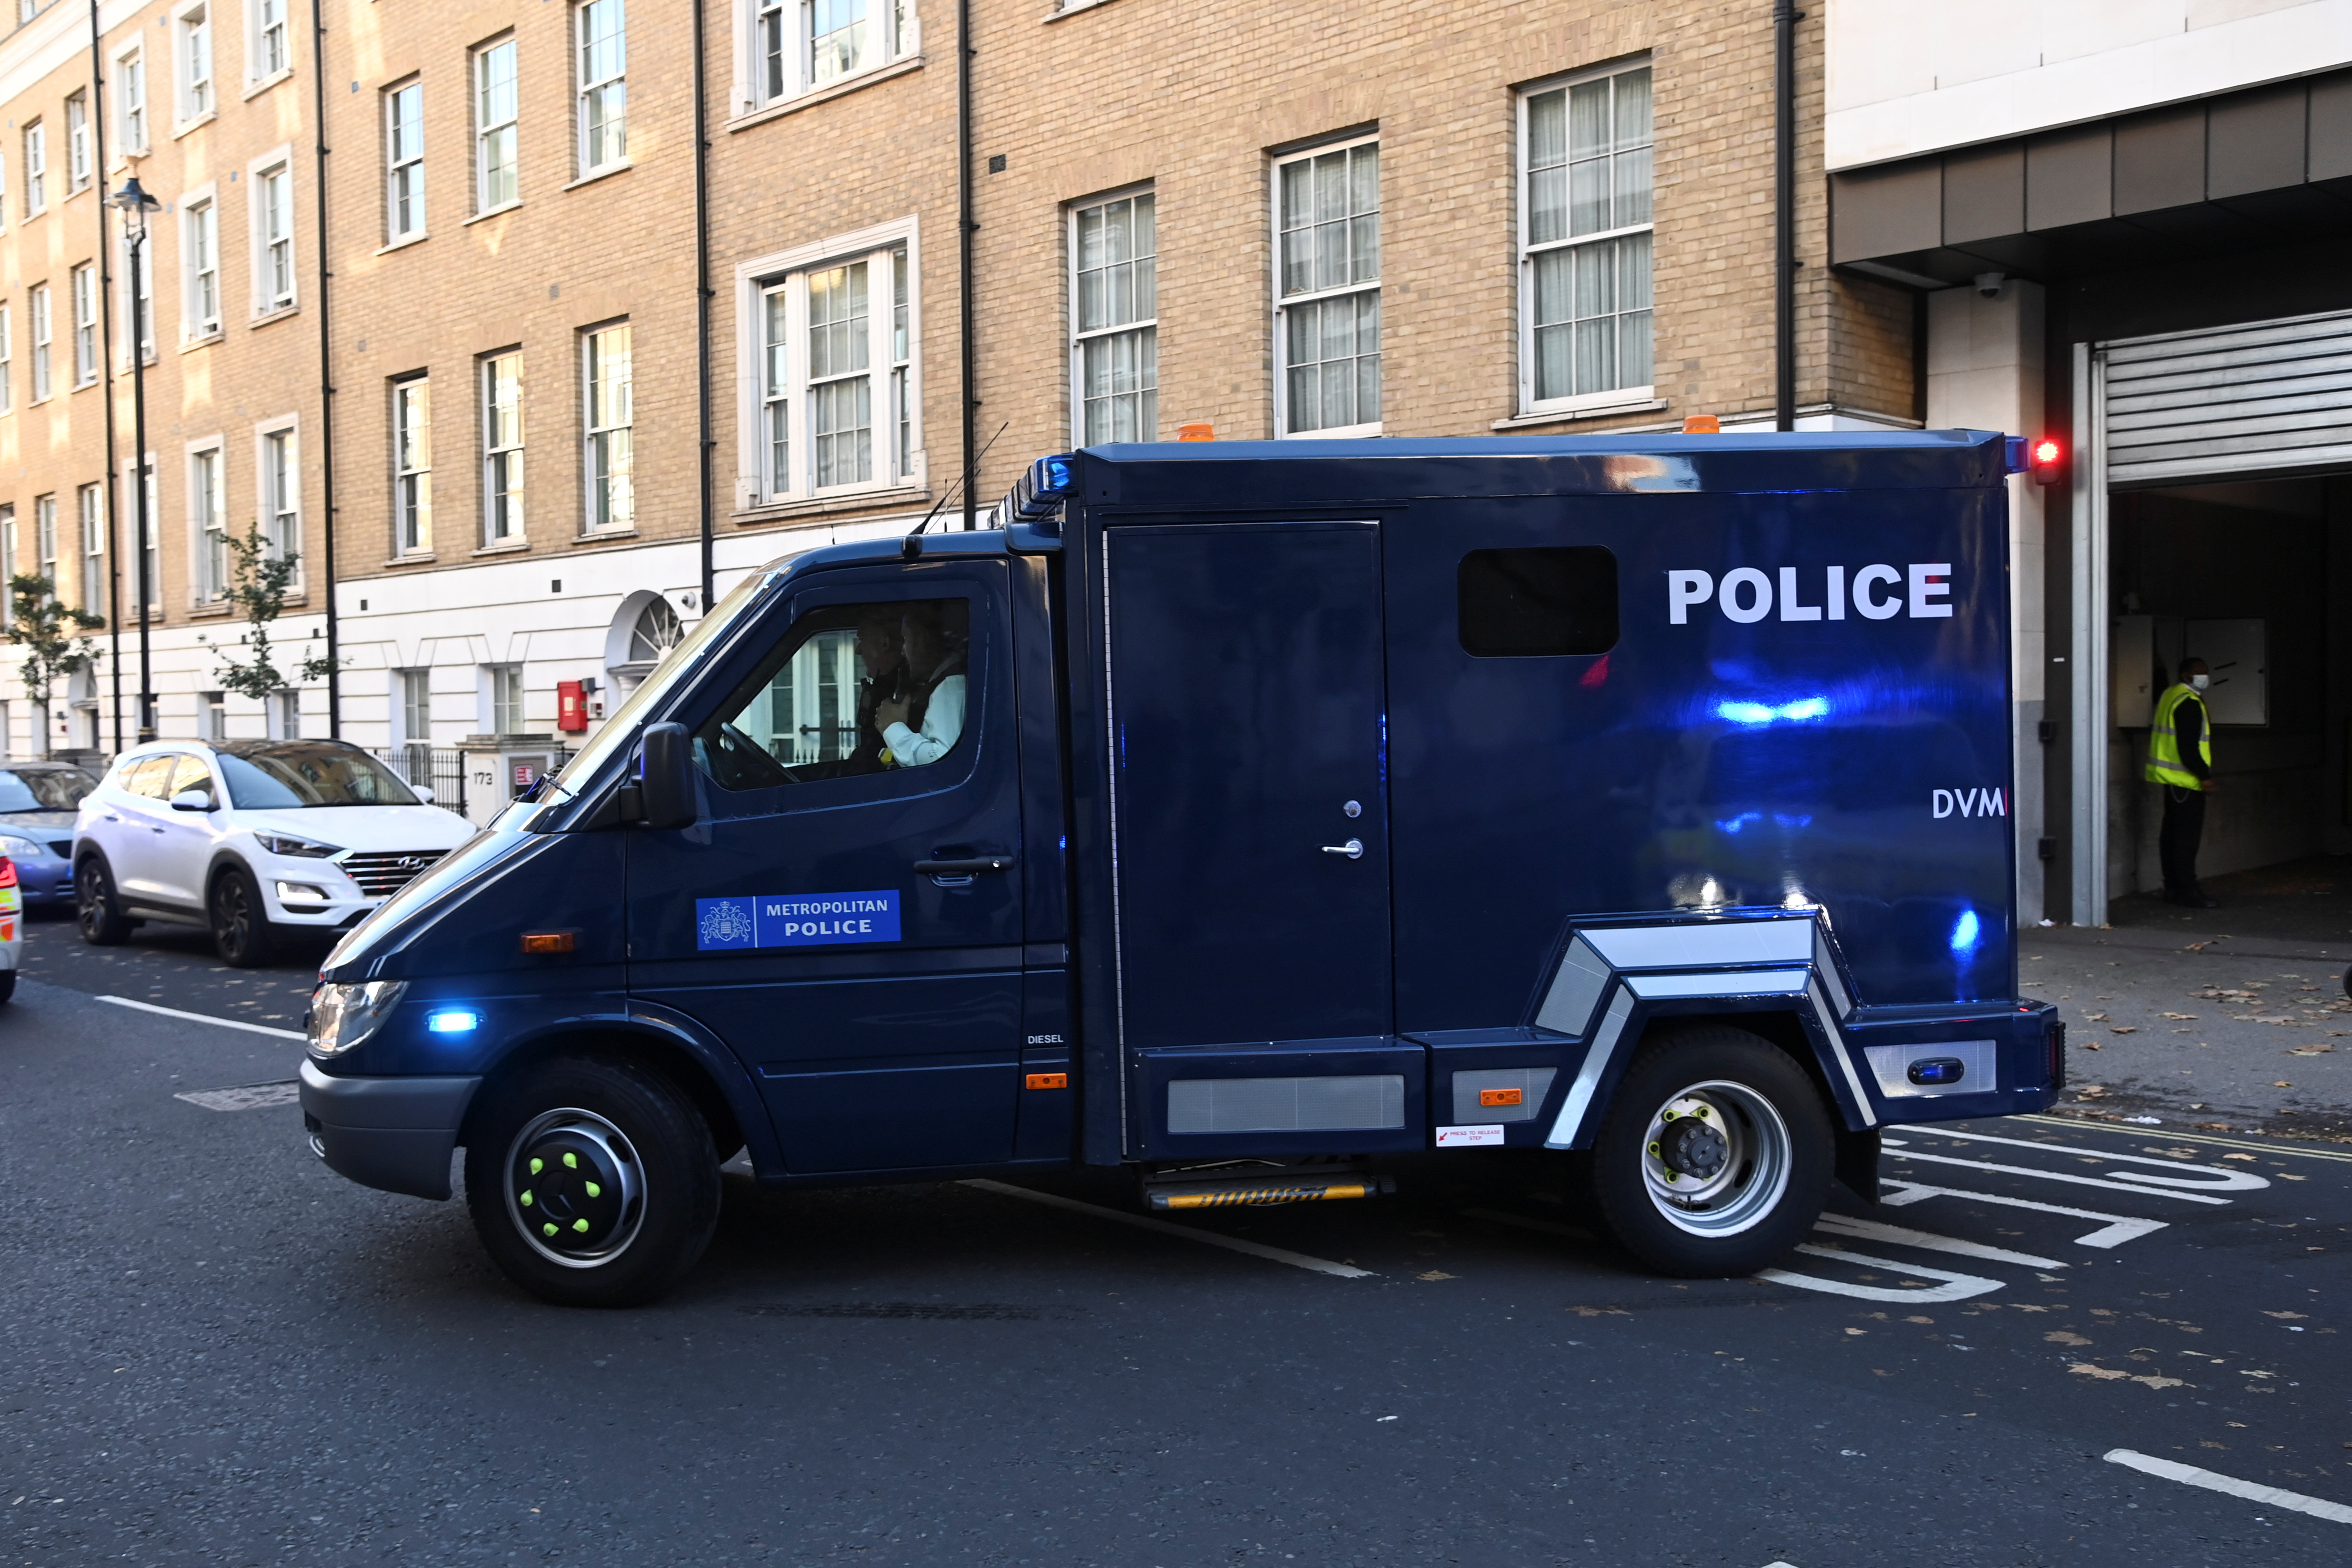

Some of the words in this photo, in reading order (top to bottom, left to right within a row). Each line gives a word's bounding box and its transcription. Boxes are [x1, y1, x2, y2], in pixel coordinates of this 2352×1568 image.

[1669, 563, 1953, 624] POLICE
[474, 772, 493, 785] 173
[1933, 787, 2005, 818] DVM
[766, 900, 888, 916] METROPOLITAN
[785, 920, 872, 936] POLICE
[1027, 1034, 1064, 1044] DIESEL
